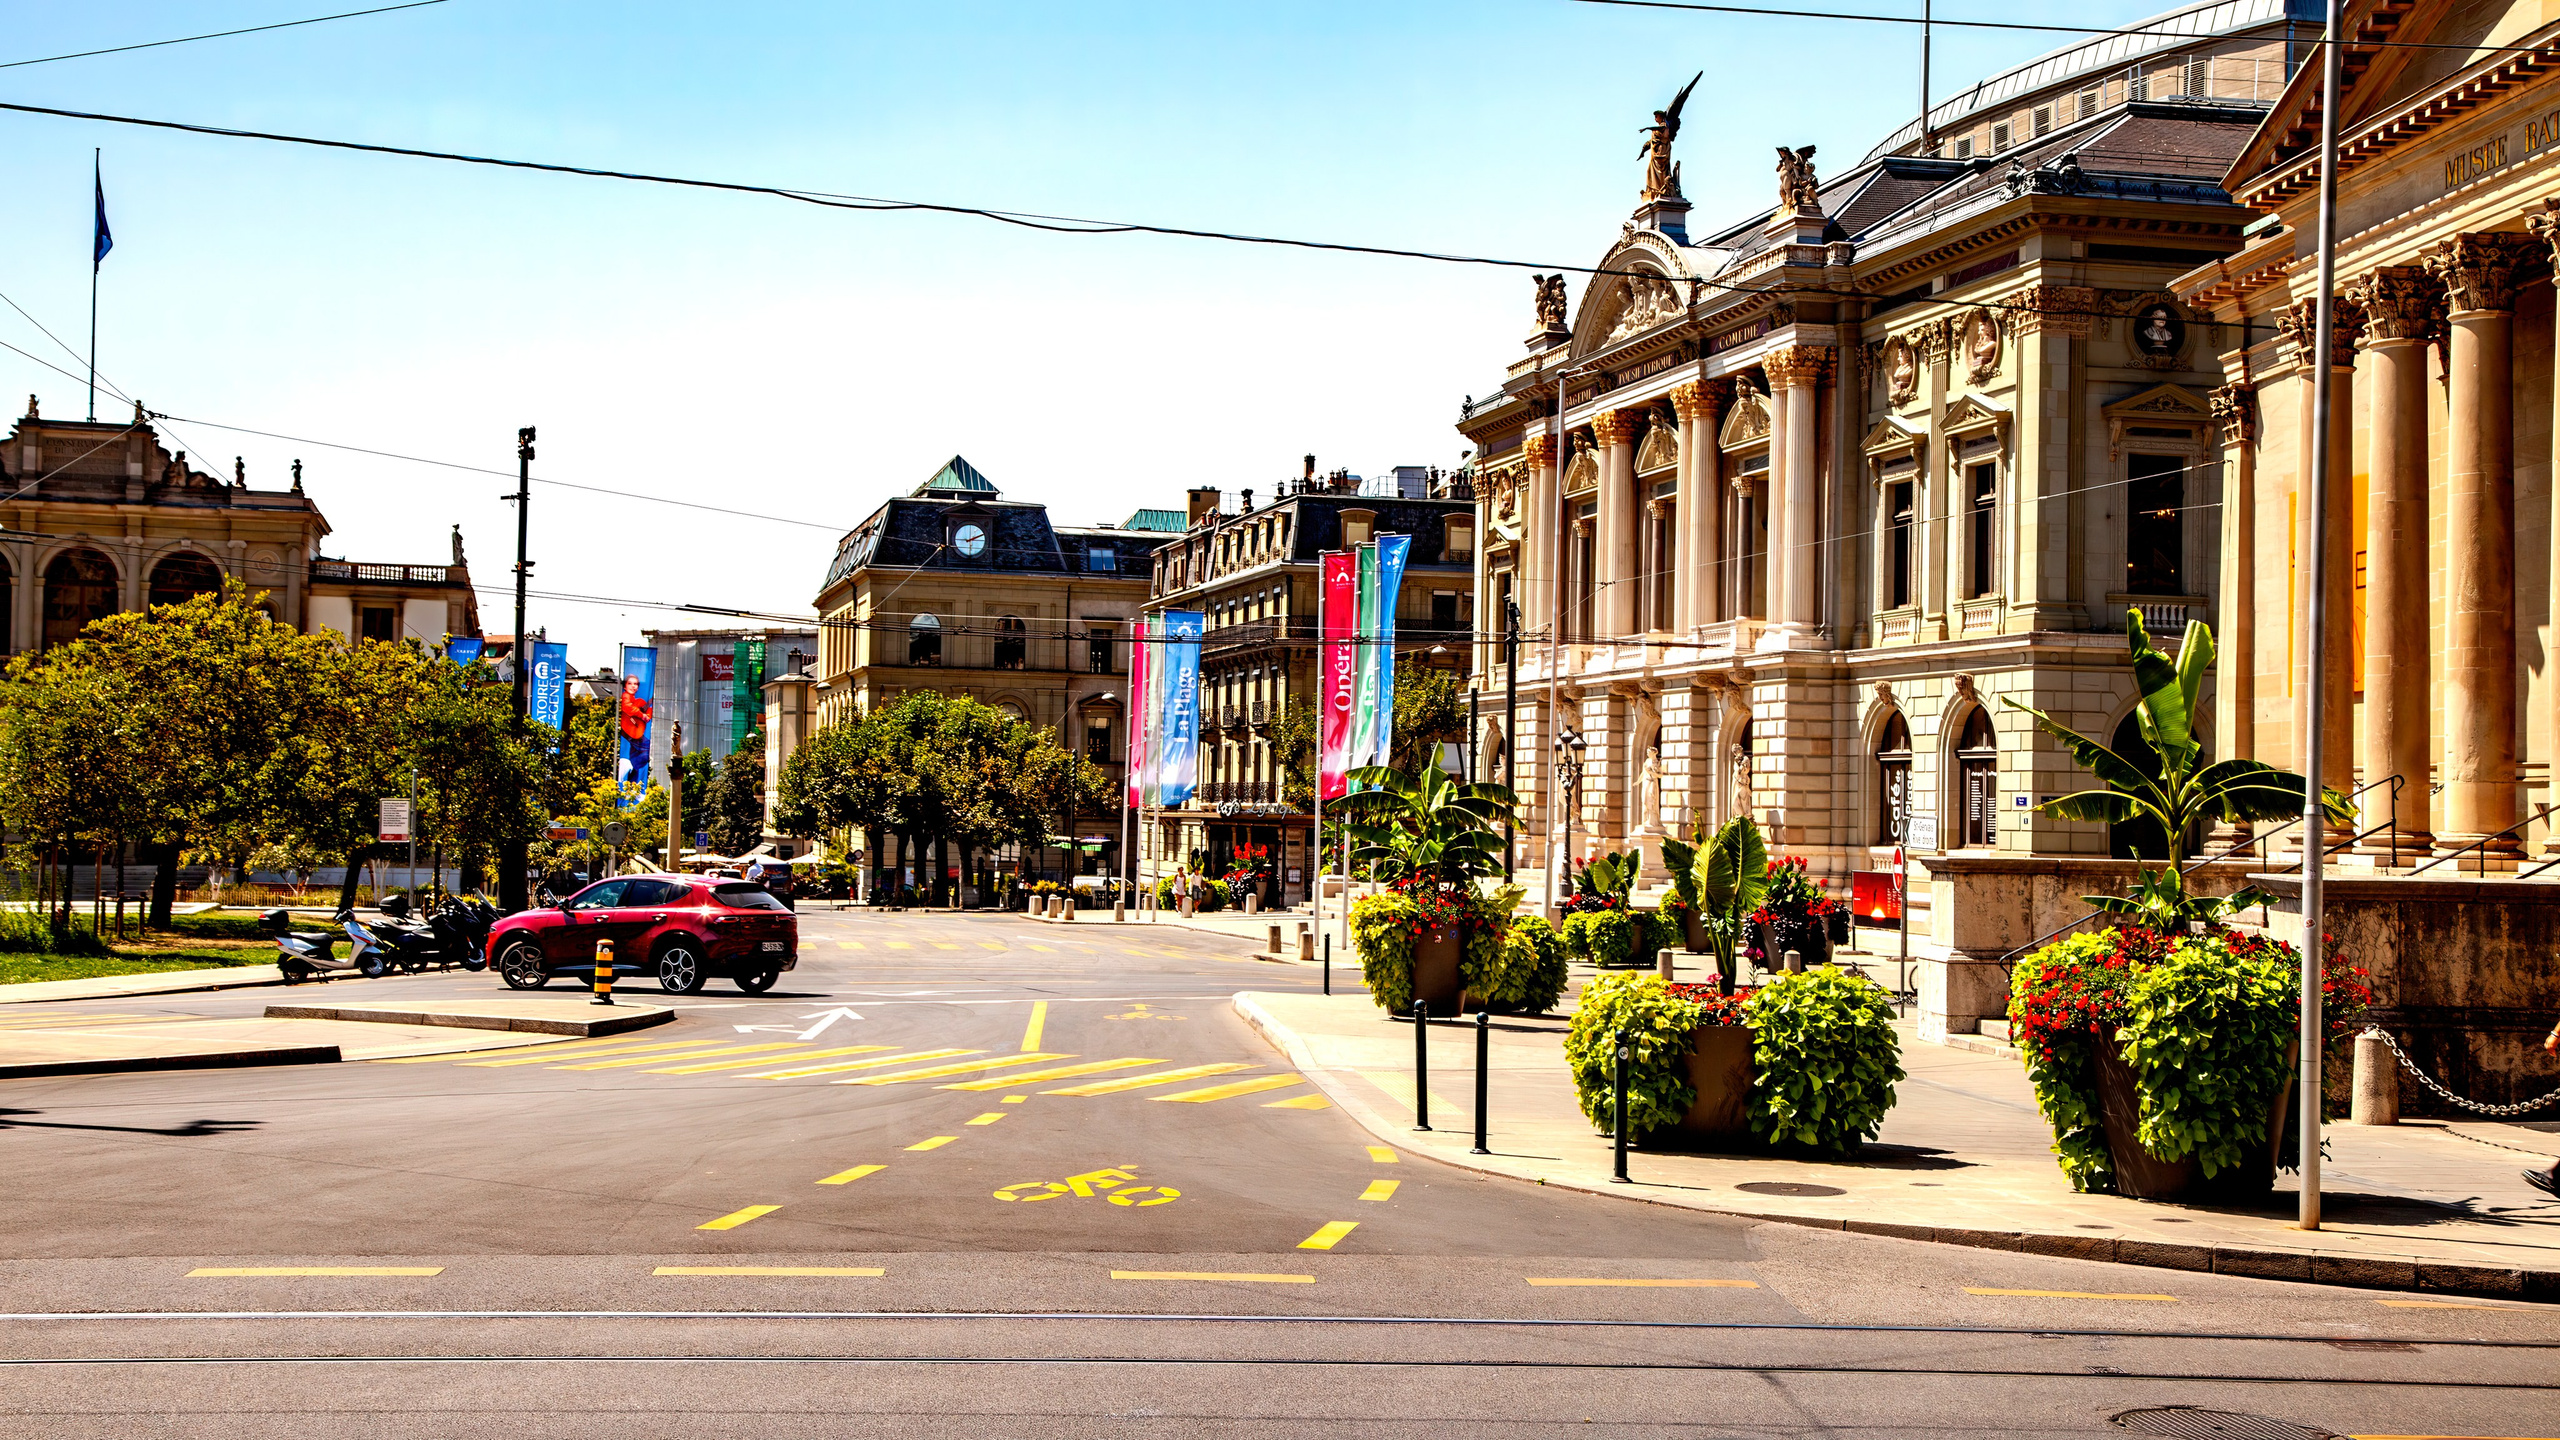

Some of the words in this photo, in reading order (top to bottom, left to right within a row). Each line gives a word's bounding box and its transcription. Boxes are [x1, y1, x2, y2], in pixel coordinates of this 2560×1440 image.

[2445, 133, 2508, 189] MUSÉE
[1173, 666, 1196, 716] Plage
[1334, 639, 1351, 711] Opéra
[1174, 719, 1189, 743] La
[1216, 800, 1241, 817] Café
[1890, 783, 1901, 838] Café
